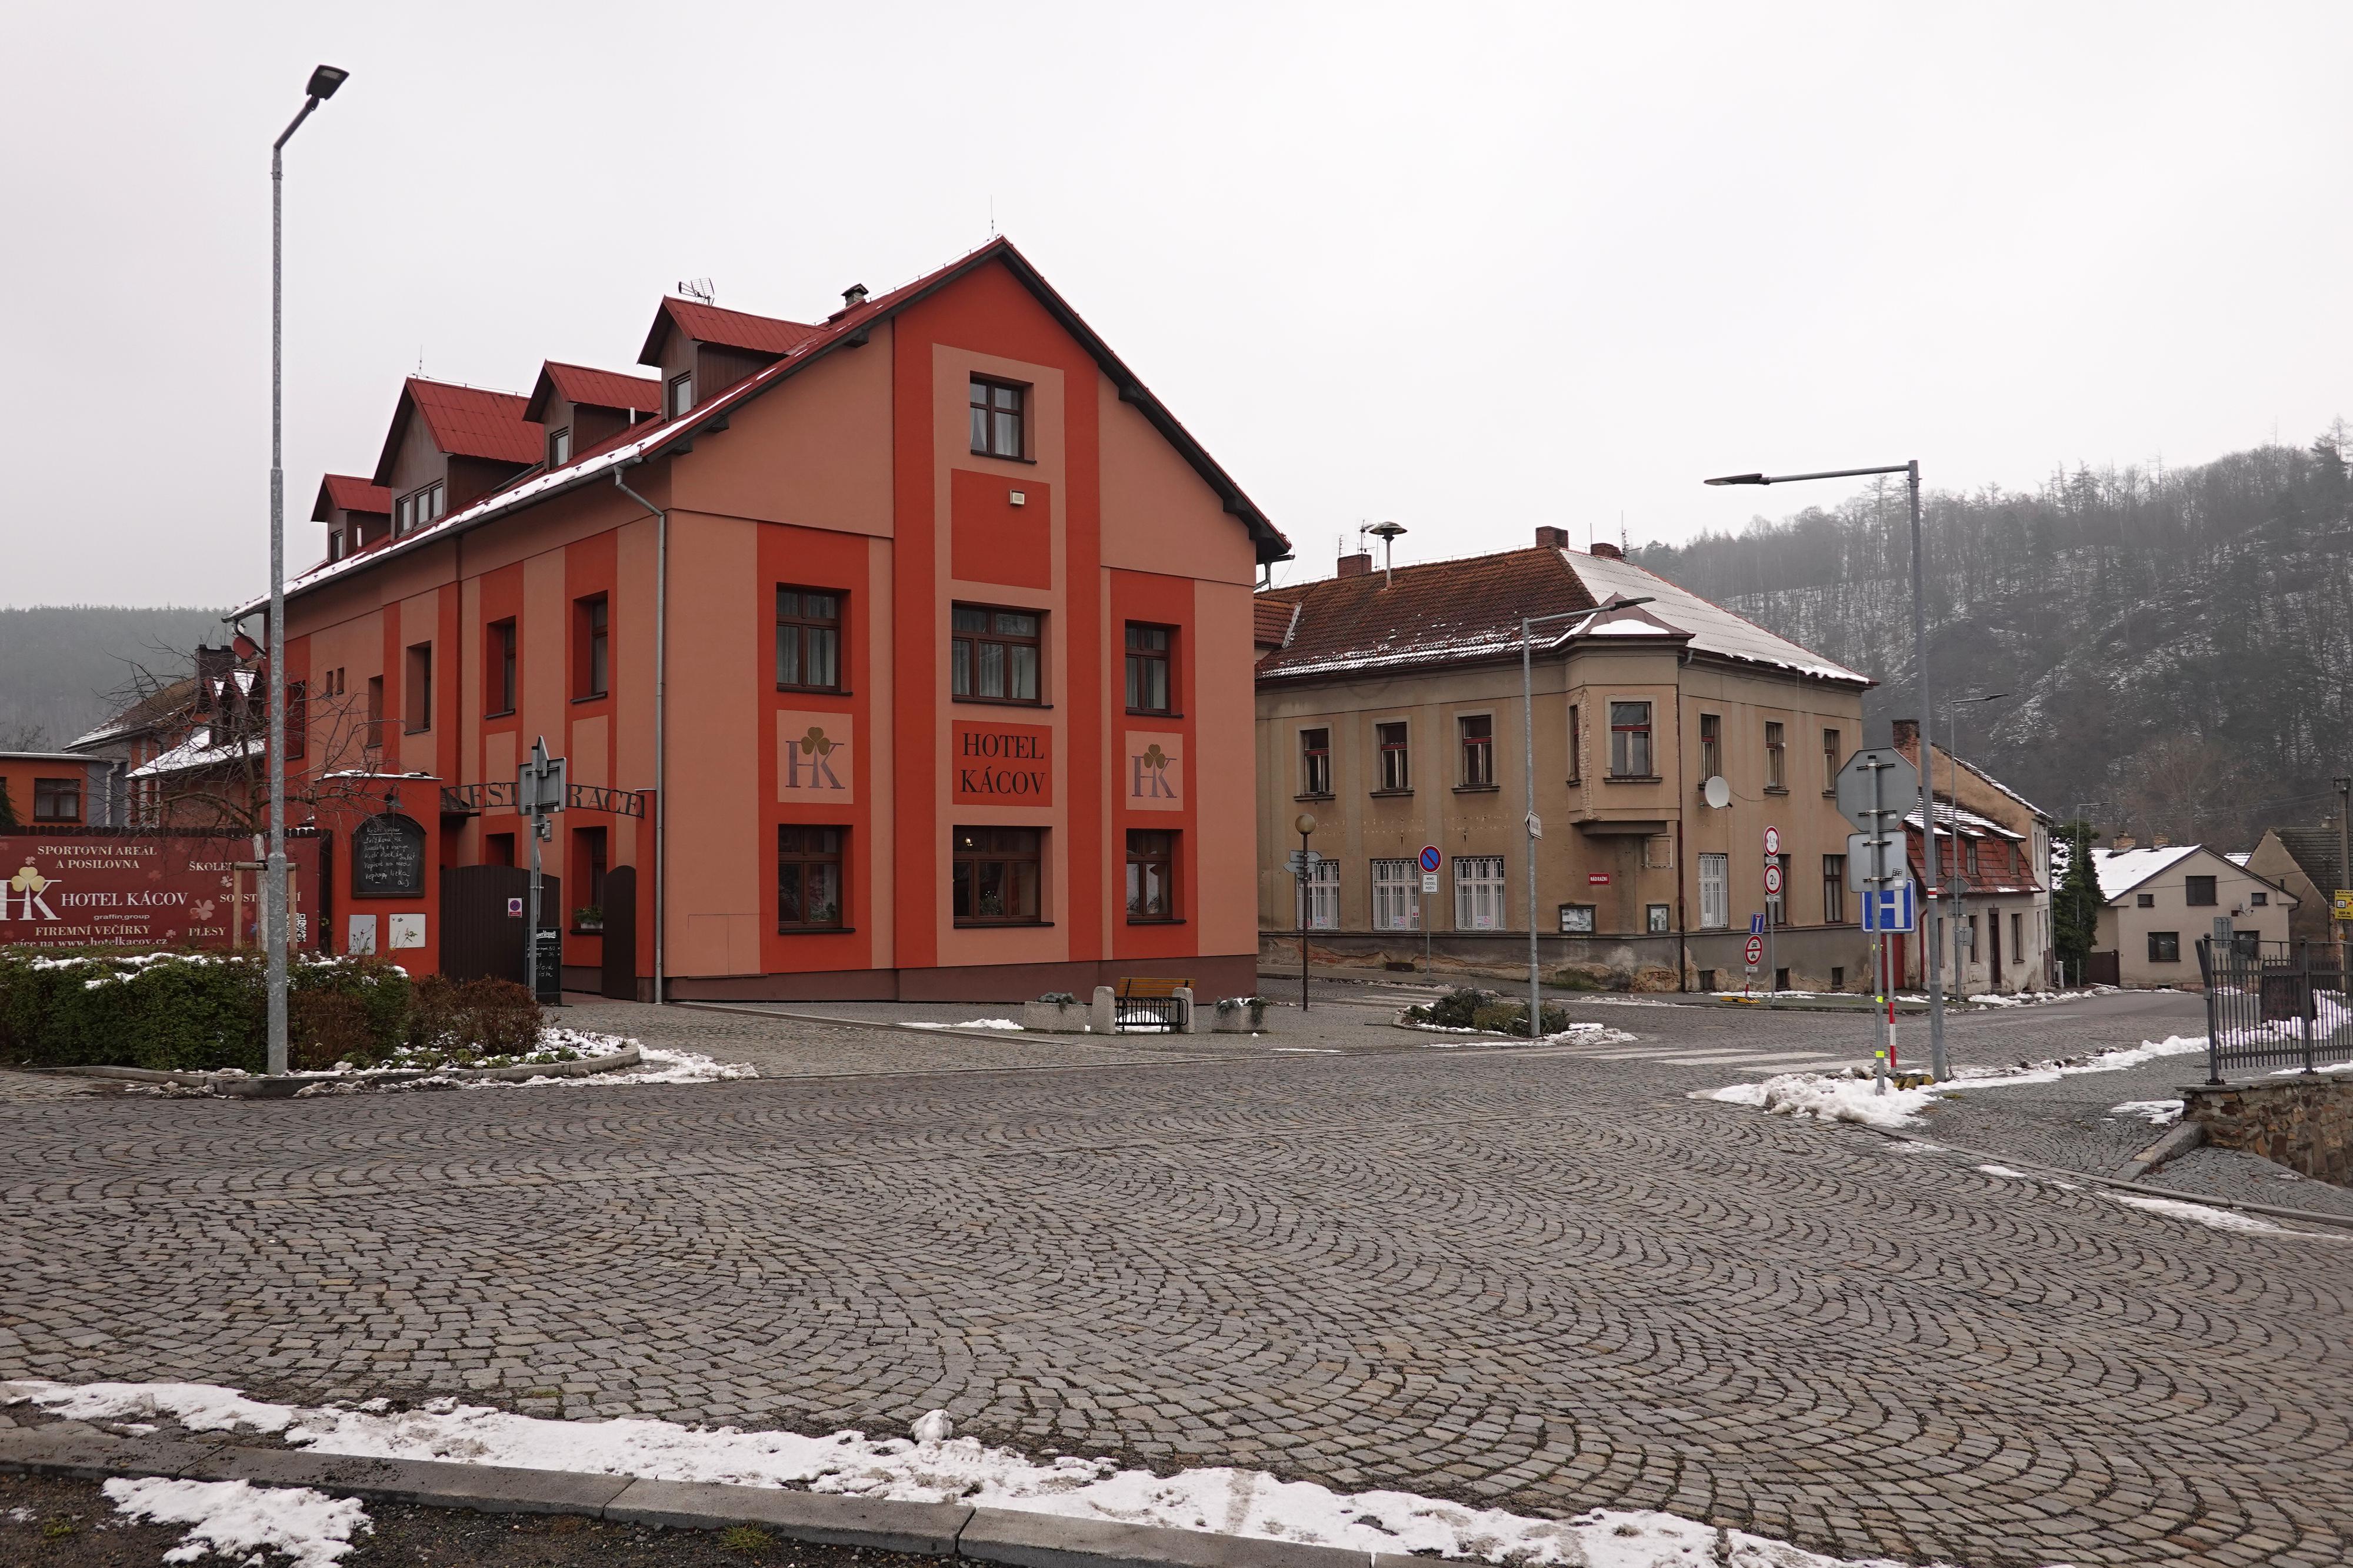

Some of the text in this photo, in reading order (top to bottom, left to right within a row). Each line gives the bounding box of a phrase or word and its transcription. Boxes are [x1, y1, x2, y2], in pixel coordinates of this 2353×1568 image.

[963, 733, 1045, 759] HOTEL
[960, 766, 1046, 795] KÁCOV
[441, 782, 644, 818] RESTRACE
[37, 845, 158, 856] SPORTOVNÍ AREÁL
[56, 859, 140, 869] A POSILOVNA
[61, 890, 189, 907] HOTEL KÁCOV
[35, 924, 151, 936] FIREMNÍ VEČÍRKY
[188, 927, 226, 936] PLESY
